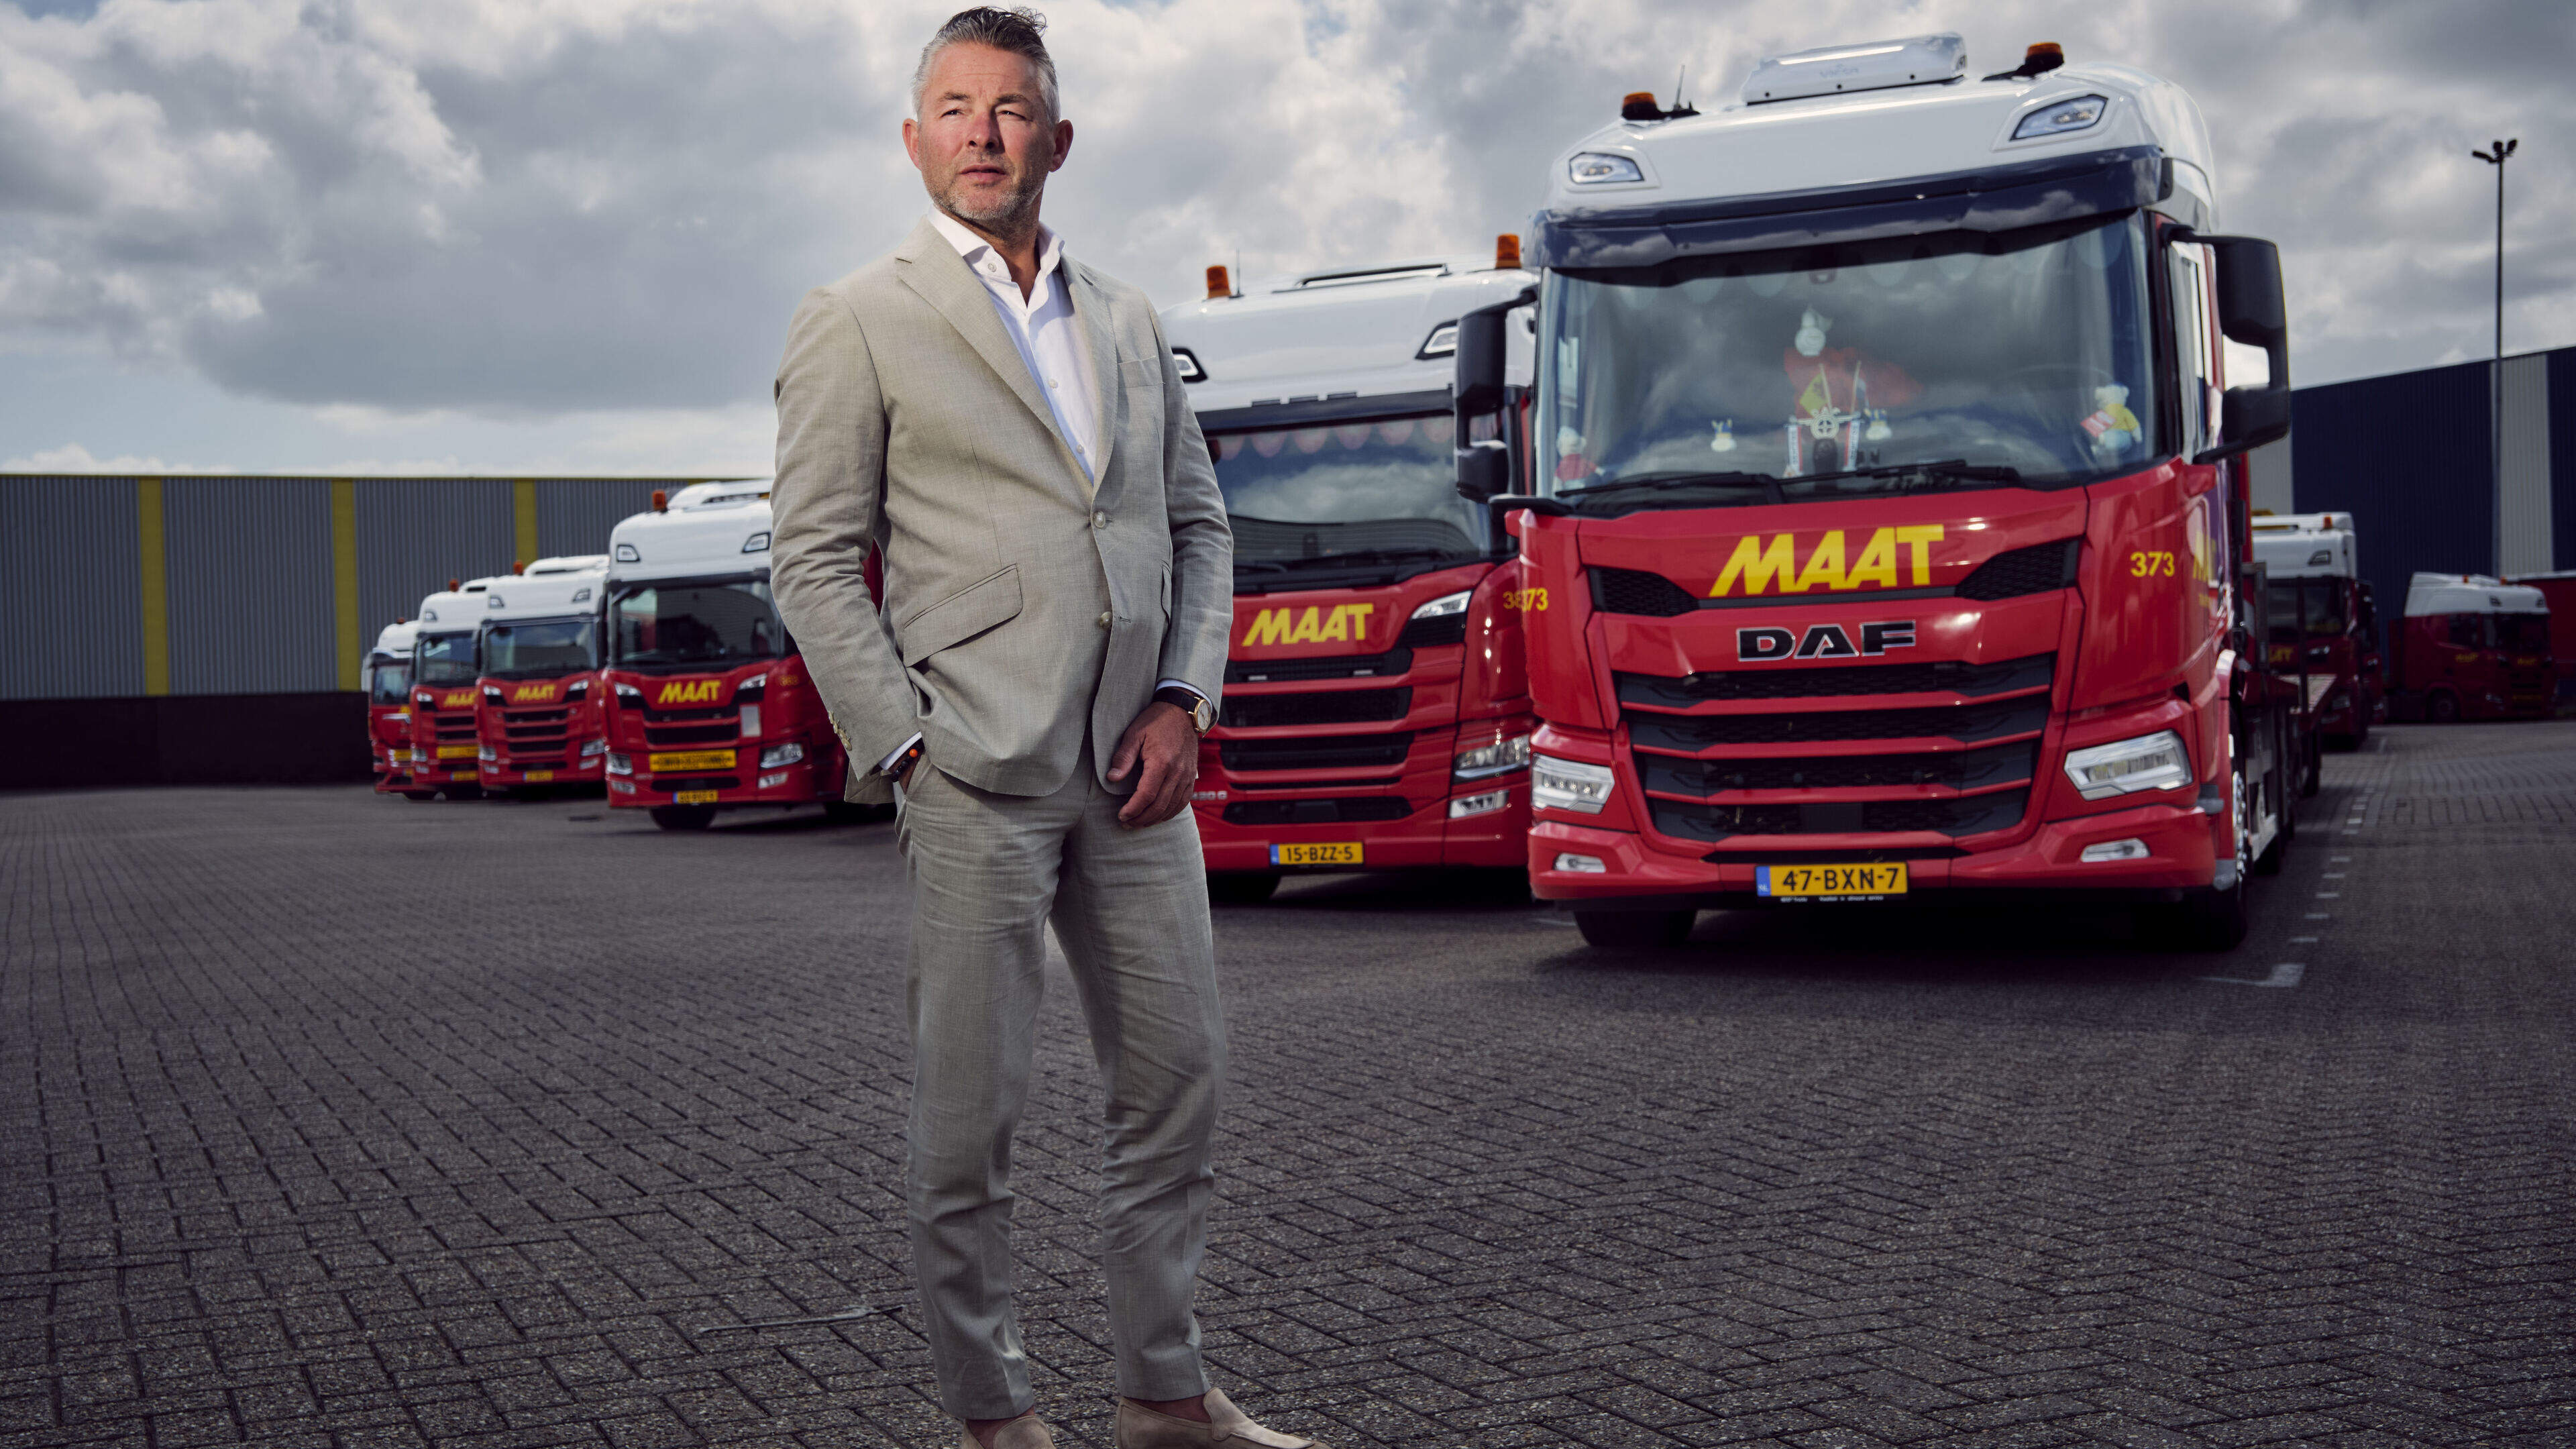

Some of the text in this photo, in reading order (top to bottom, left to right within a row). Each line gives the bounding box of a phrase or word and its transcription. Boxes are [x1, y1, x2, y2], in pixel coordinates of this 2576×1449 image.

[1709, 524, 1945, 596] MAAT
[2130, 551, 2175, 577] 373
[1242, 602, 1375, 647] MAAT
[1736, 619, 1916, 661] DAF
[514, 684, 556, 701] MAAT
[658, 680, 721, 704] MAAT
[1287, 845, 1353, 862] 15-BZZ-5
[1782, 867, 1899, 892] 47-BXN-7
